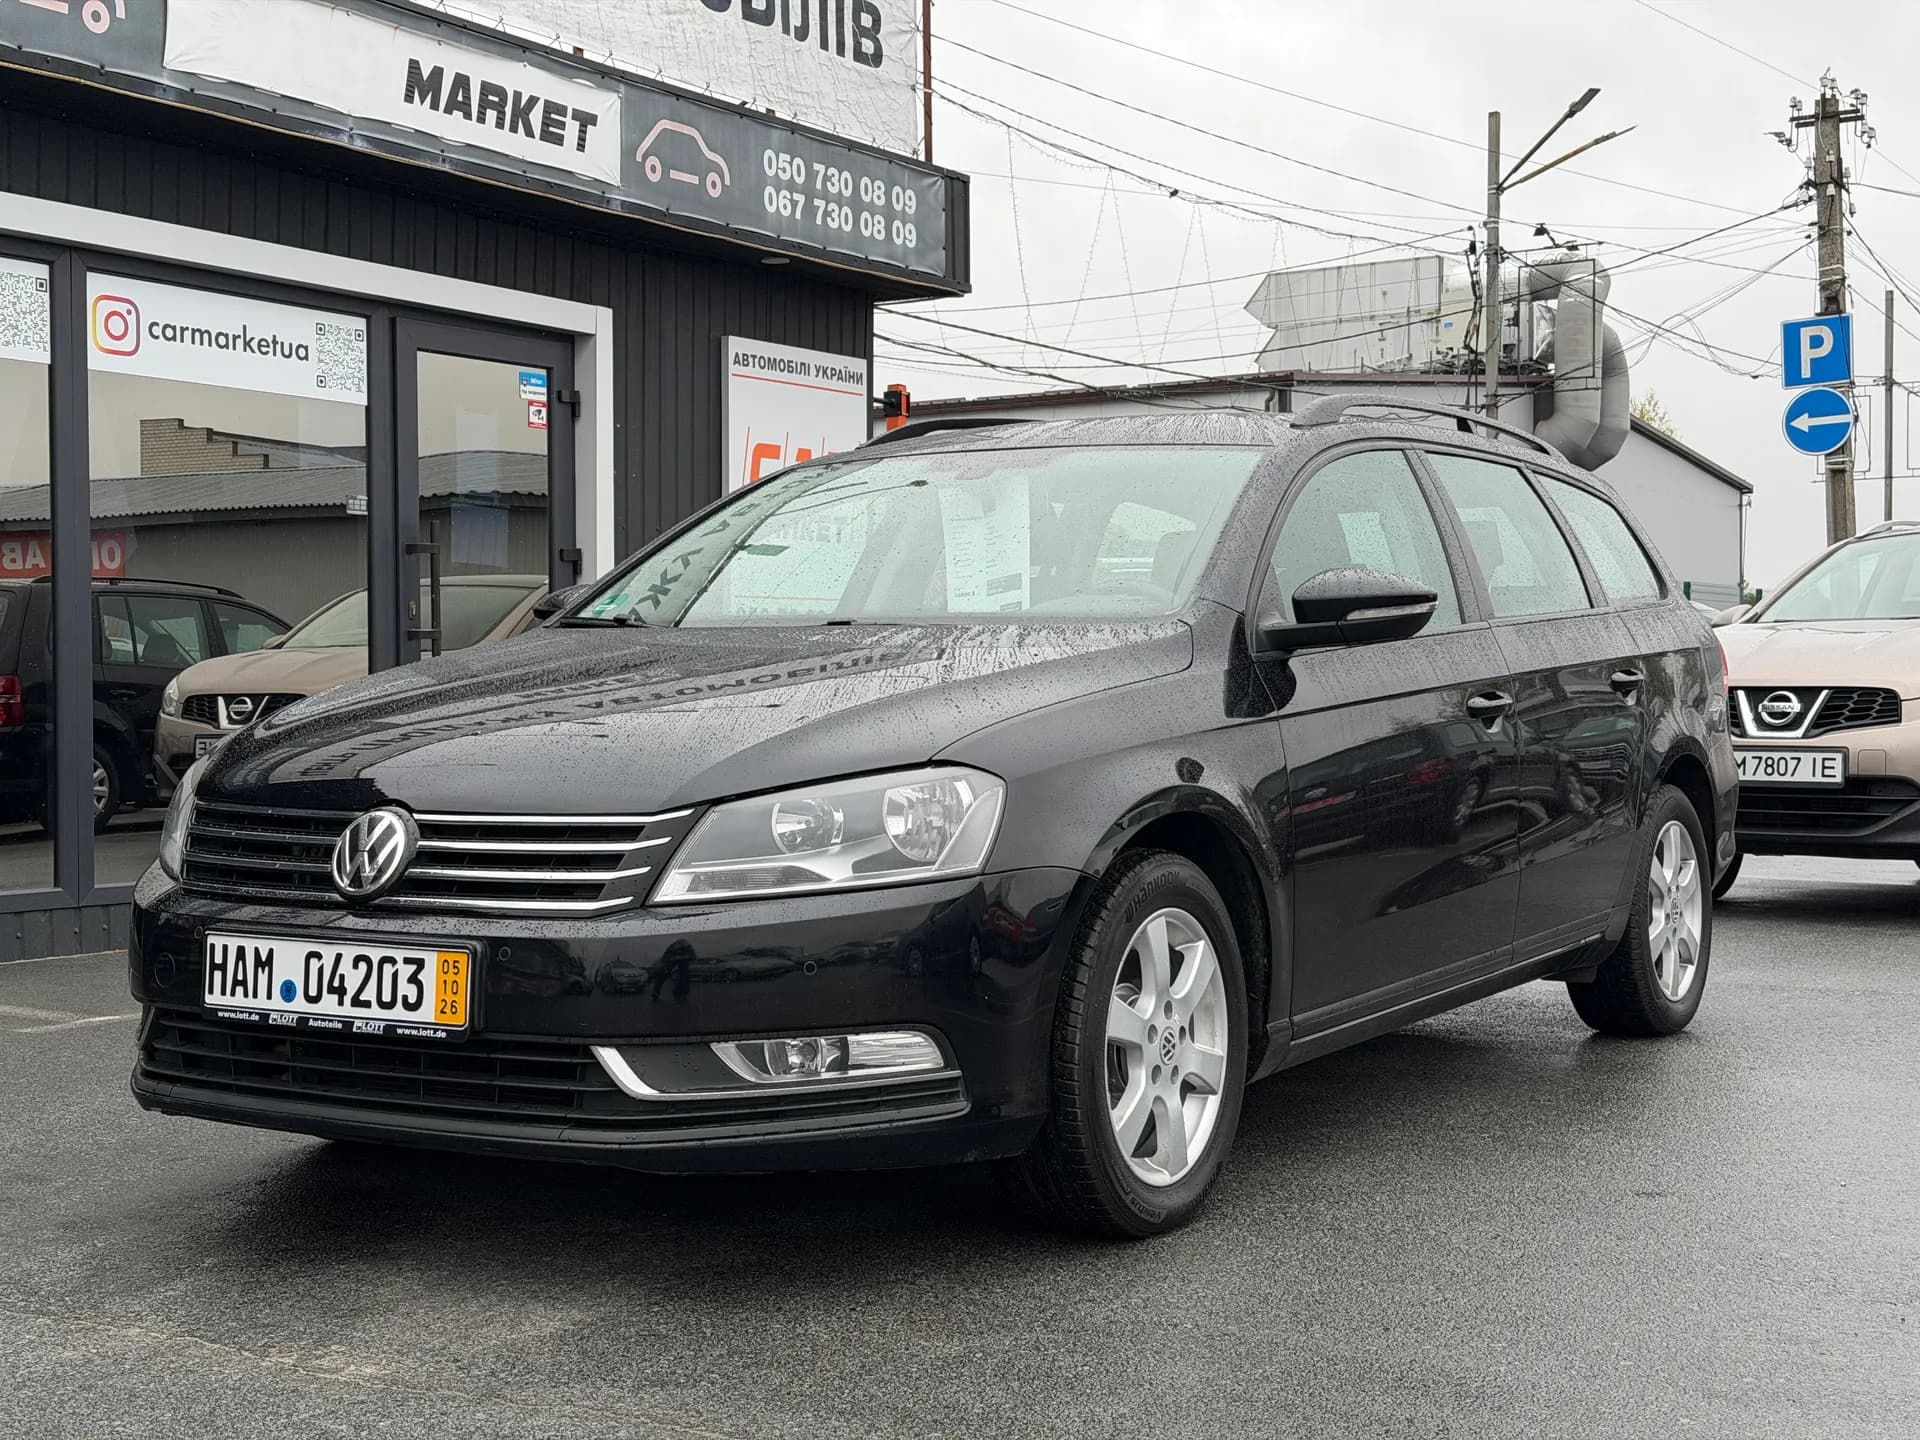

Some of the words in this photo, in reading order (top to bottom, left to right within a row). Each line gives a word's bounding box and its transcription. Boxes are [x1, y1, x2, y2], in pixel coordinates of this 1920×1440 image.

[404, 58, 598, 152] MARKET
[763, 149, 806, 184] 050
[814, 163, 852, 197] 730
[860, 176, 886, 206] 08
[892, 185, 917, 214] 09
[763, 186, 806, 219] 067
[814, 198, 852, 232] 730
[860, 211, 886, 240] 08
[892, 219, 917, 248] 09
[148, 320, 310, 362] carmarketua
[1800, 325, 1834, 379] P
[732, 351, 811, 377] АВТОМОБІЛІ
[814, 363, 864, 386] УКРАЇНИ
[1760, 703, 1796, 712] NISSAN
[1811, 756, 1838, 779] IE
[208, 942, 274, 1000] HAM
[303, 950, 426, 1012] 04203
[441, 959, 461, 976] 05
[441, 979, 459, 996] 10
[217, 1010, 260, 1021] www.lott.de
[277, 1013, 298, 1025] LOTT
[308, 1019, 343, 1030] Autoteile
[361, 1022, 386, 1032] LOTT
[396, 1026, 447, 1039] www.lott.de
[440, 999, 458, 1015] 26
